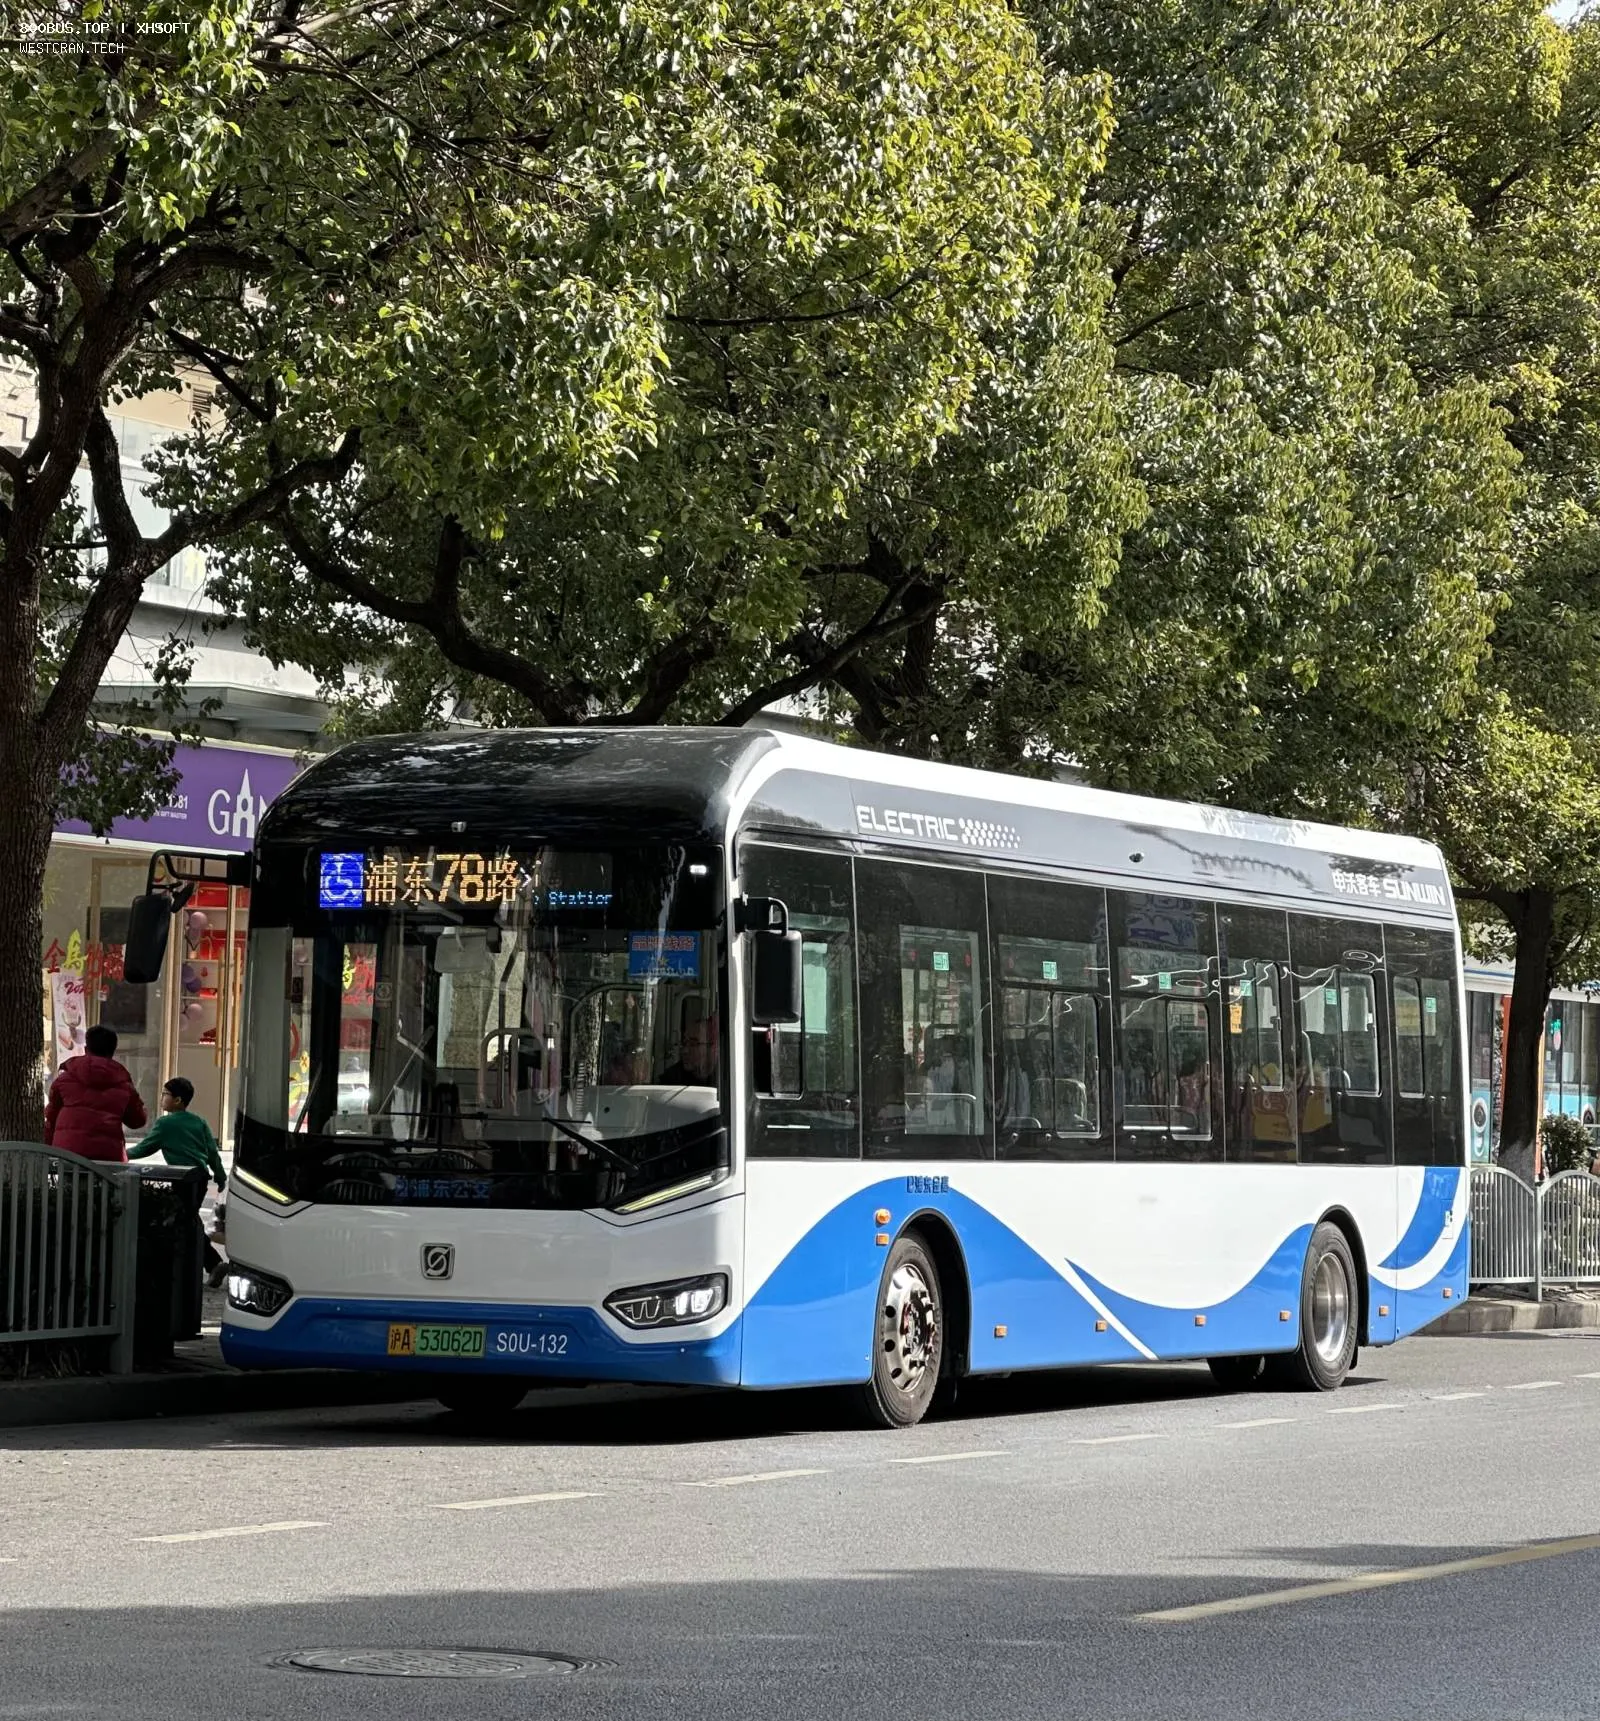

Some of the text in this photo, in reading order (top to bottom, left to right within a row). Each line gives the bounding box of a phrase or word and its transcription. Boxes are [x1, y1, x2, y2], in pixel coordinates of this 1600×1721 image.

[856, 805, 958, 842] ELECTRIC
[364, 854, 521, 906] 浦东78路
[1332, 868, 1446, 906] 申沃客车 SUNWIN
